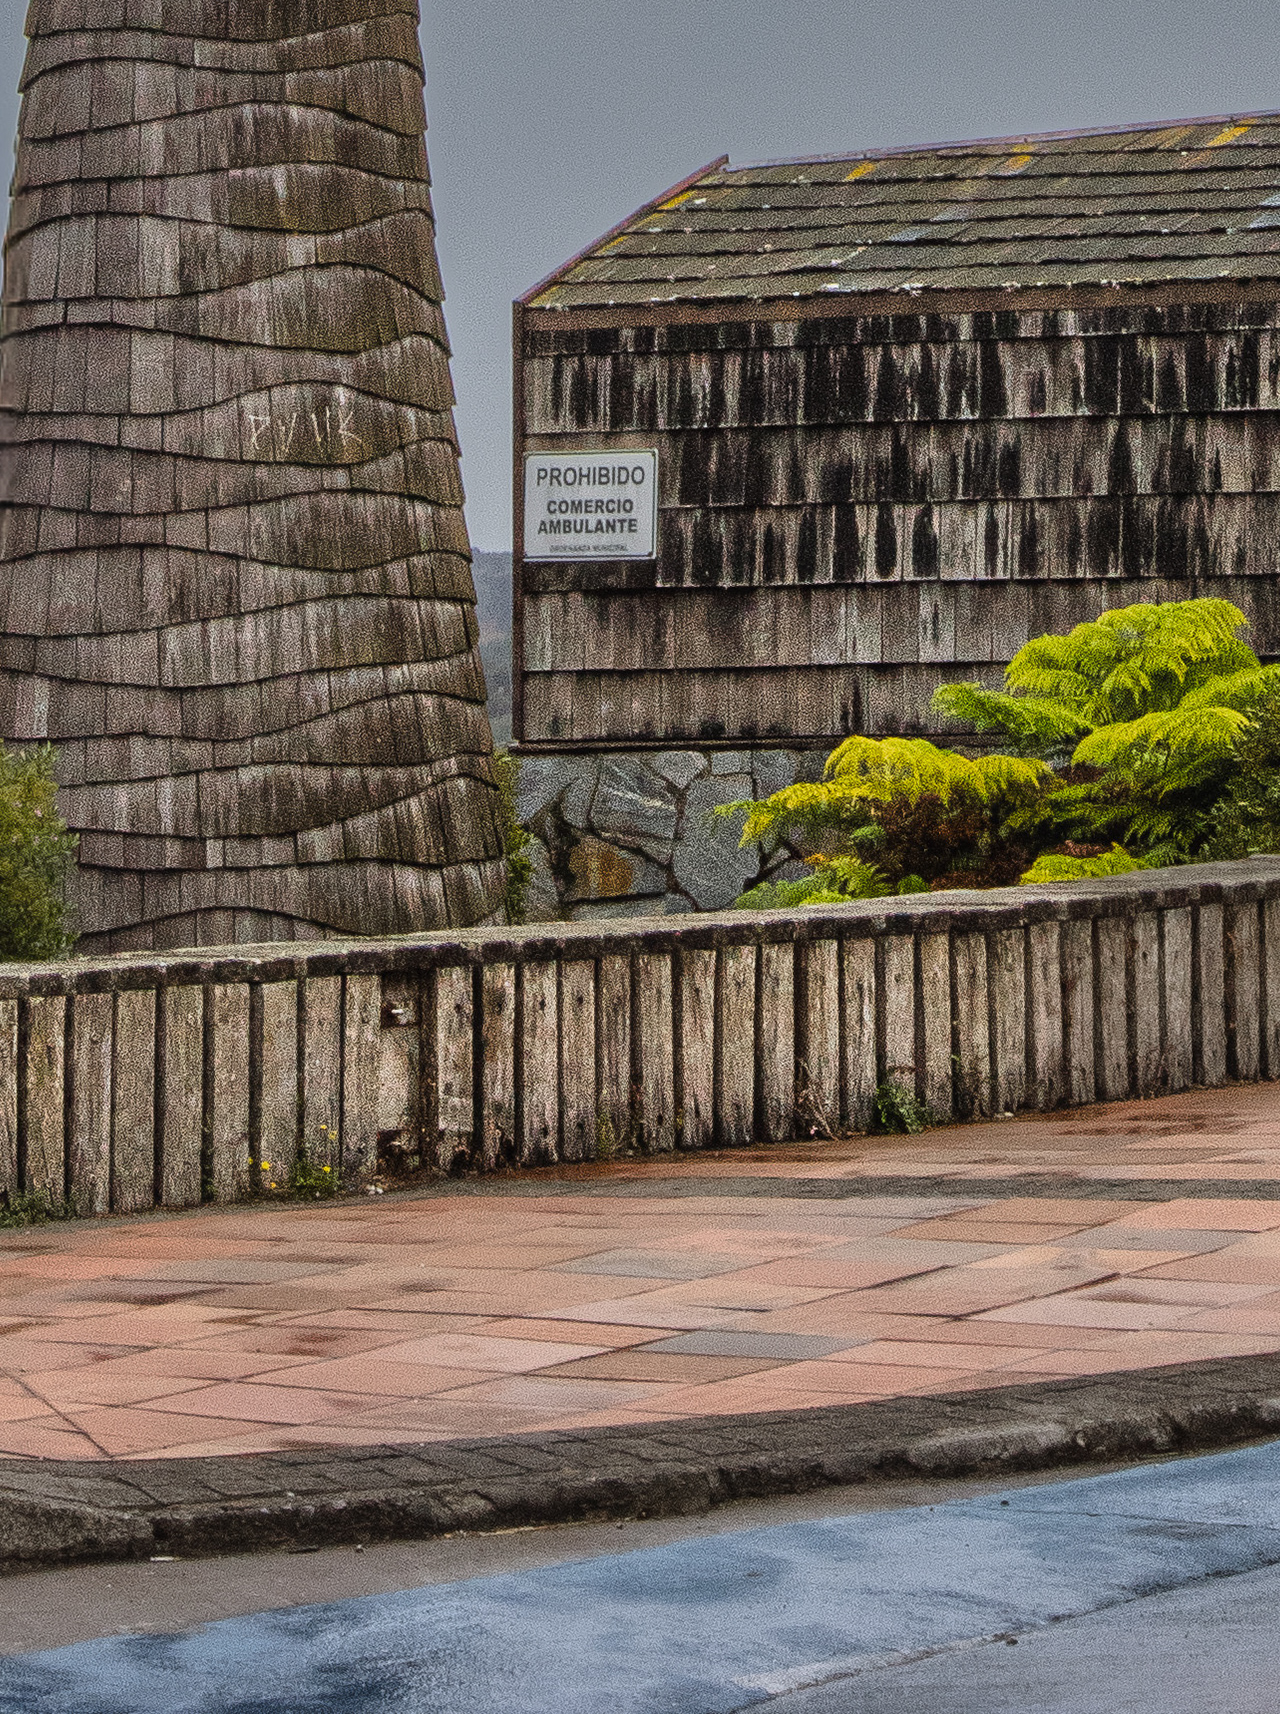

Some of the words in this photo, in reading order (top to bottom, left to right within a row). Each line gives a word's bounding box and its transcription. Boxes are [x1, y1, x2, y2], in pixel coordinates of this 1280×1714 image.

[537, 466, 645, 487] PROHIBIDO
[547, 499, 634, 514] COMERCIO
[538, 518, 638, 535] AMBULANTE
